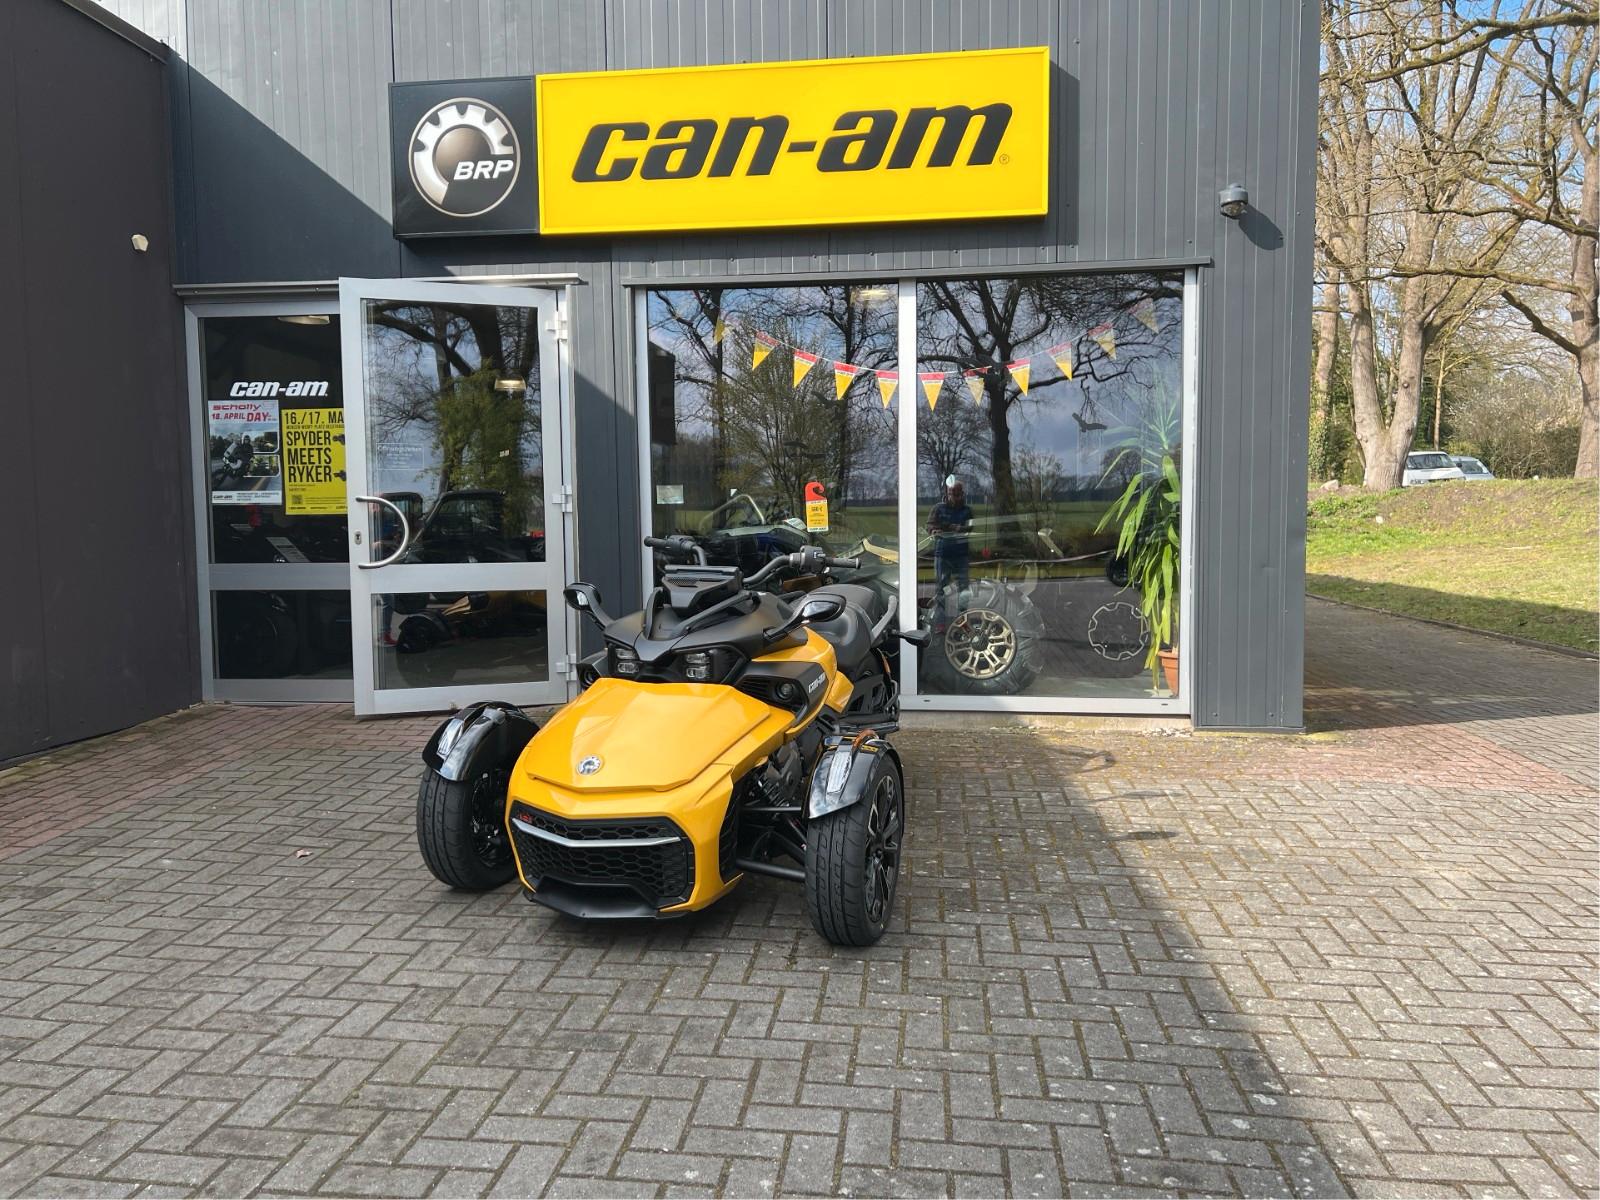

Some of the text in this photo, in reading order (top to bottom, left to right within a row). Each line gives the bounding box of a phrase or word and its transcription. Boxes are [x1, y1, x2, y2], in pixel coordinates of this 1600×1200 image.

[571, 102, 1013, 183] can-am
[453, 159, 514, 180] BRP
[230, 381, 329, 397] can-am
[224, 412, 245, 420] APRIL
[246, 412, 269, 422] DAY
[285, 411, 325, 424] 16./17.
[286, 431, 331, 446] SPYDER
[287, 447, 332, 465] MEETS
[288, 465, 332, 483] RYKER
